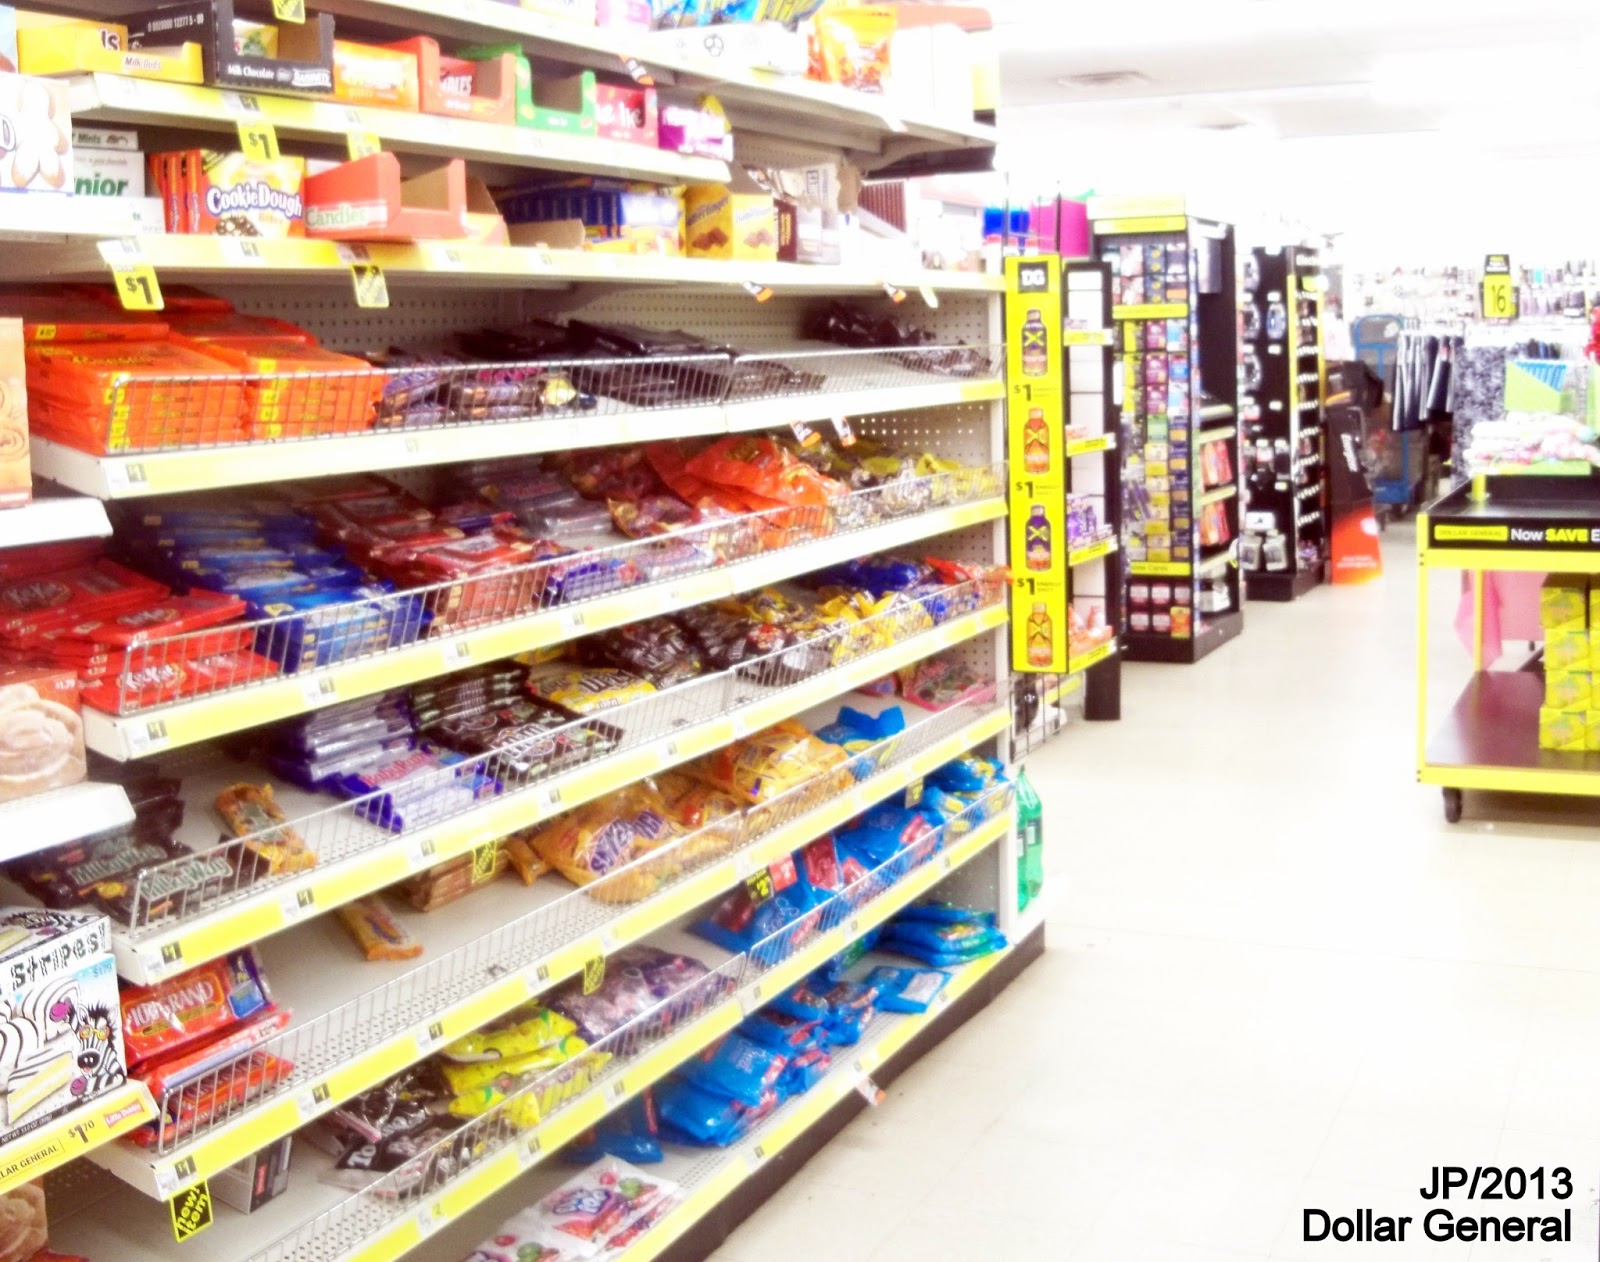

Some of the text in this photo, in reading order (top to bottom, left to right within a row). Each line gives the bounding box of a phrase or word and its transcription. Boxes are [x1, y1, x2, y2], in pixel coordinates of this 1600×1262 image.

[248, 132, 271, 160] $1
[74, 172, 129, 197] nior
[1021, 269, 1045, 286] DG
[125, 276, 154, 305] $1
[1013, 383, 1032, 401] $1
[1015, 480, 1034, 499] $1
[1510, 528, 1543, 541] Now
[1545, 528, 1588, 542] SAVE
[1017, 577, 1035, 596] $1
[20, 1144, 59, 1168] GENERAL
